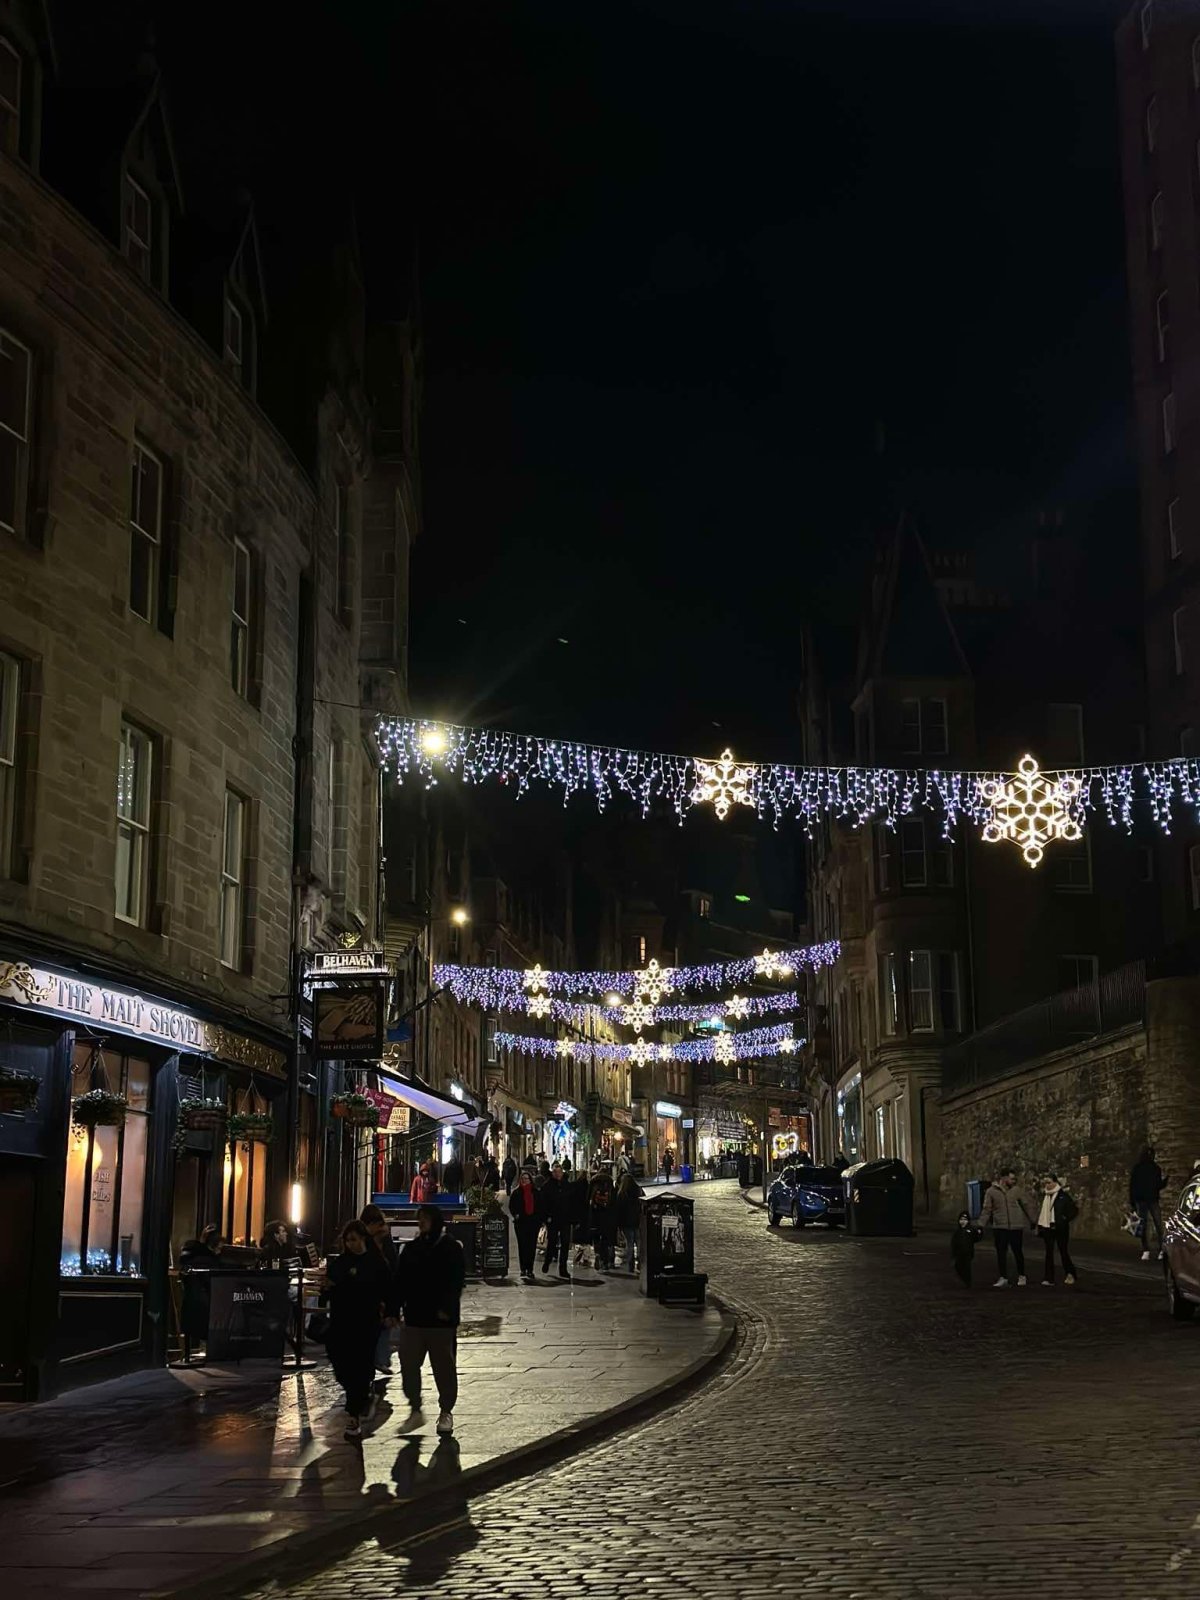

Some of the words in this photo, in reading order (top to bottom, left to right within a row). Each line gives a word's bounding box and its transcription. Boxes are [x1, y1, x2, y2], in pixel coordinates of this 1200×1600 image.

[322, 954, 375, 969] BELHAVEN
[54, 978, 93, 1014] THE
[100, 990, 145, 1028] MALT
[150, 1007, 202, 1046] SHOVEL
[233, 1291, 265, 1302] BELHAVEN
